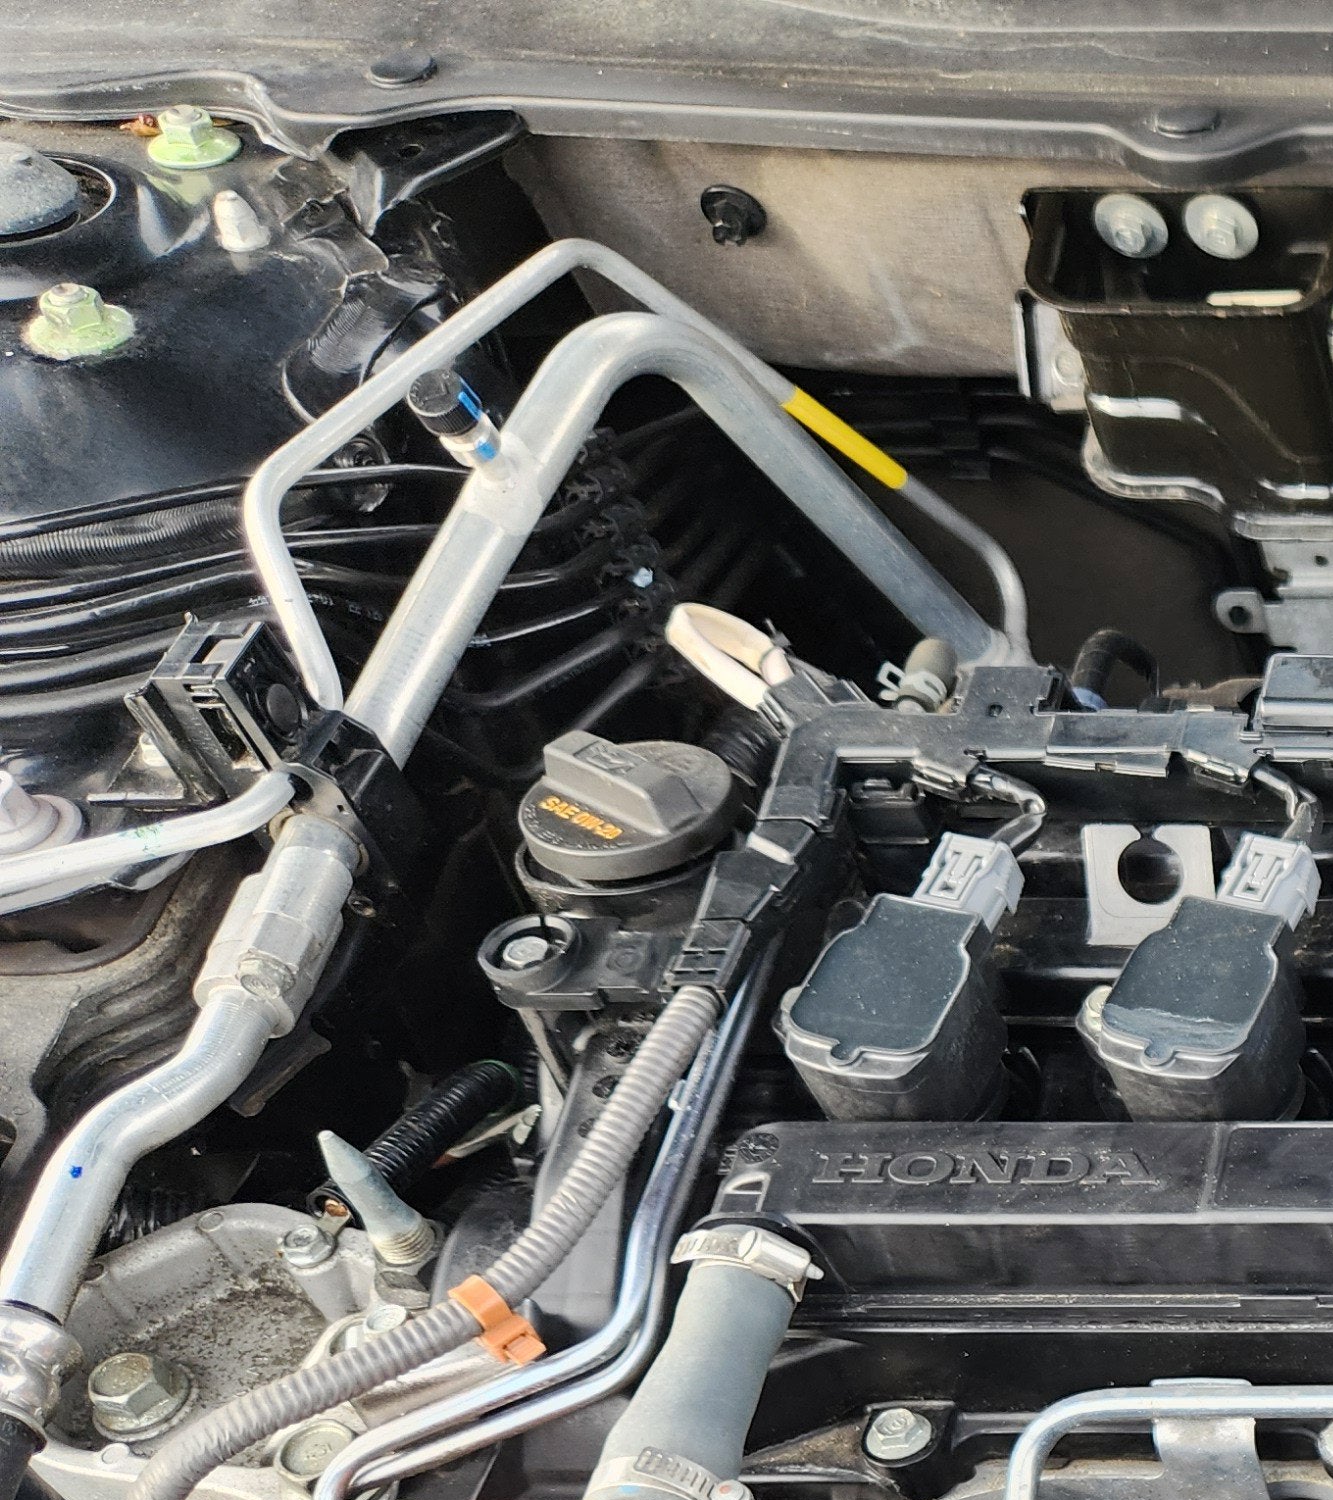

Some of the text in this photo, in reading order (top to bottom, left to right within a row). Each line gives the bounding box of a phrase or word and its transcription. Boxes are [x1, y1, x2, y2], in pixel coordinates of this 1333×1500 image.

[538, 795, 580, 820] SAE
[571, 811, 624, 840] 0W-20
[812, 1151, 1163, 1185] HONDA
